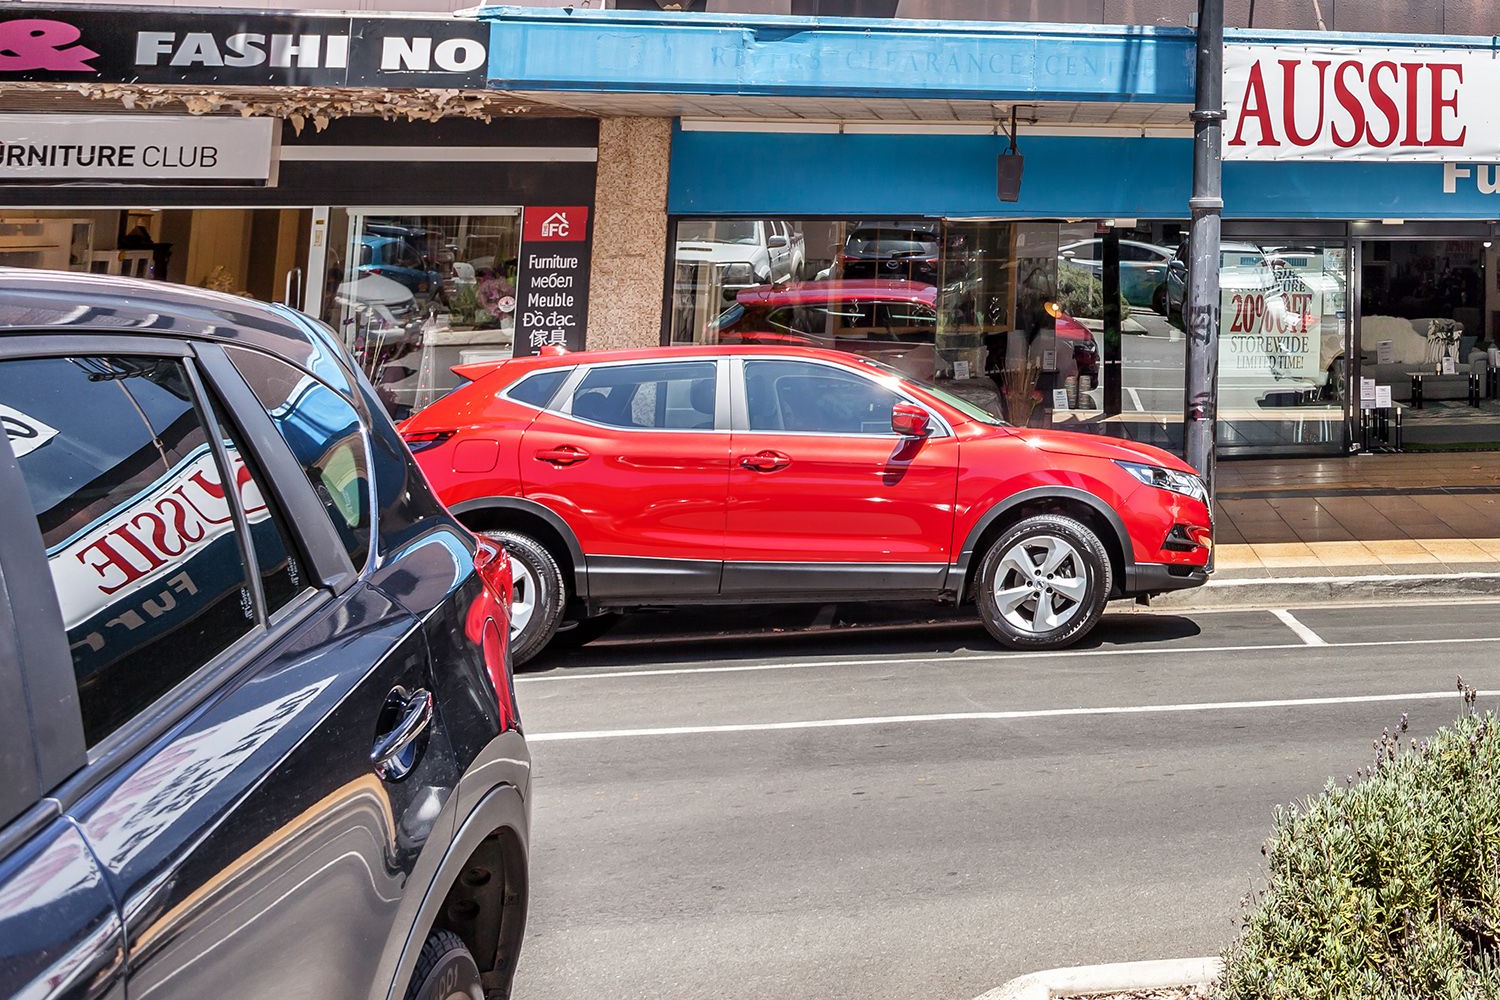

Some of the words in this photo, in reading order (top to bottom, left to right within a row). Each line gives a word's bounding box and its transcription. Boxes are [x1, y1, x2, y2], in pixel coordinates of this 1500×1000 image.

[135, 31, 348, 68] FASHI
[380, 37, 487, 71] NO
[1228, 59, 1467, 149] AUSSIE
[142, 145, 218, 168] CLUB
[528, 254, 578, 269] Furniture
[528, 292, 574, 307] Meuble
[1230, 336, 1309, 353] STOREWIDE
